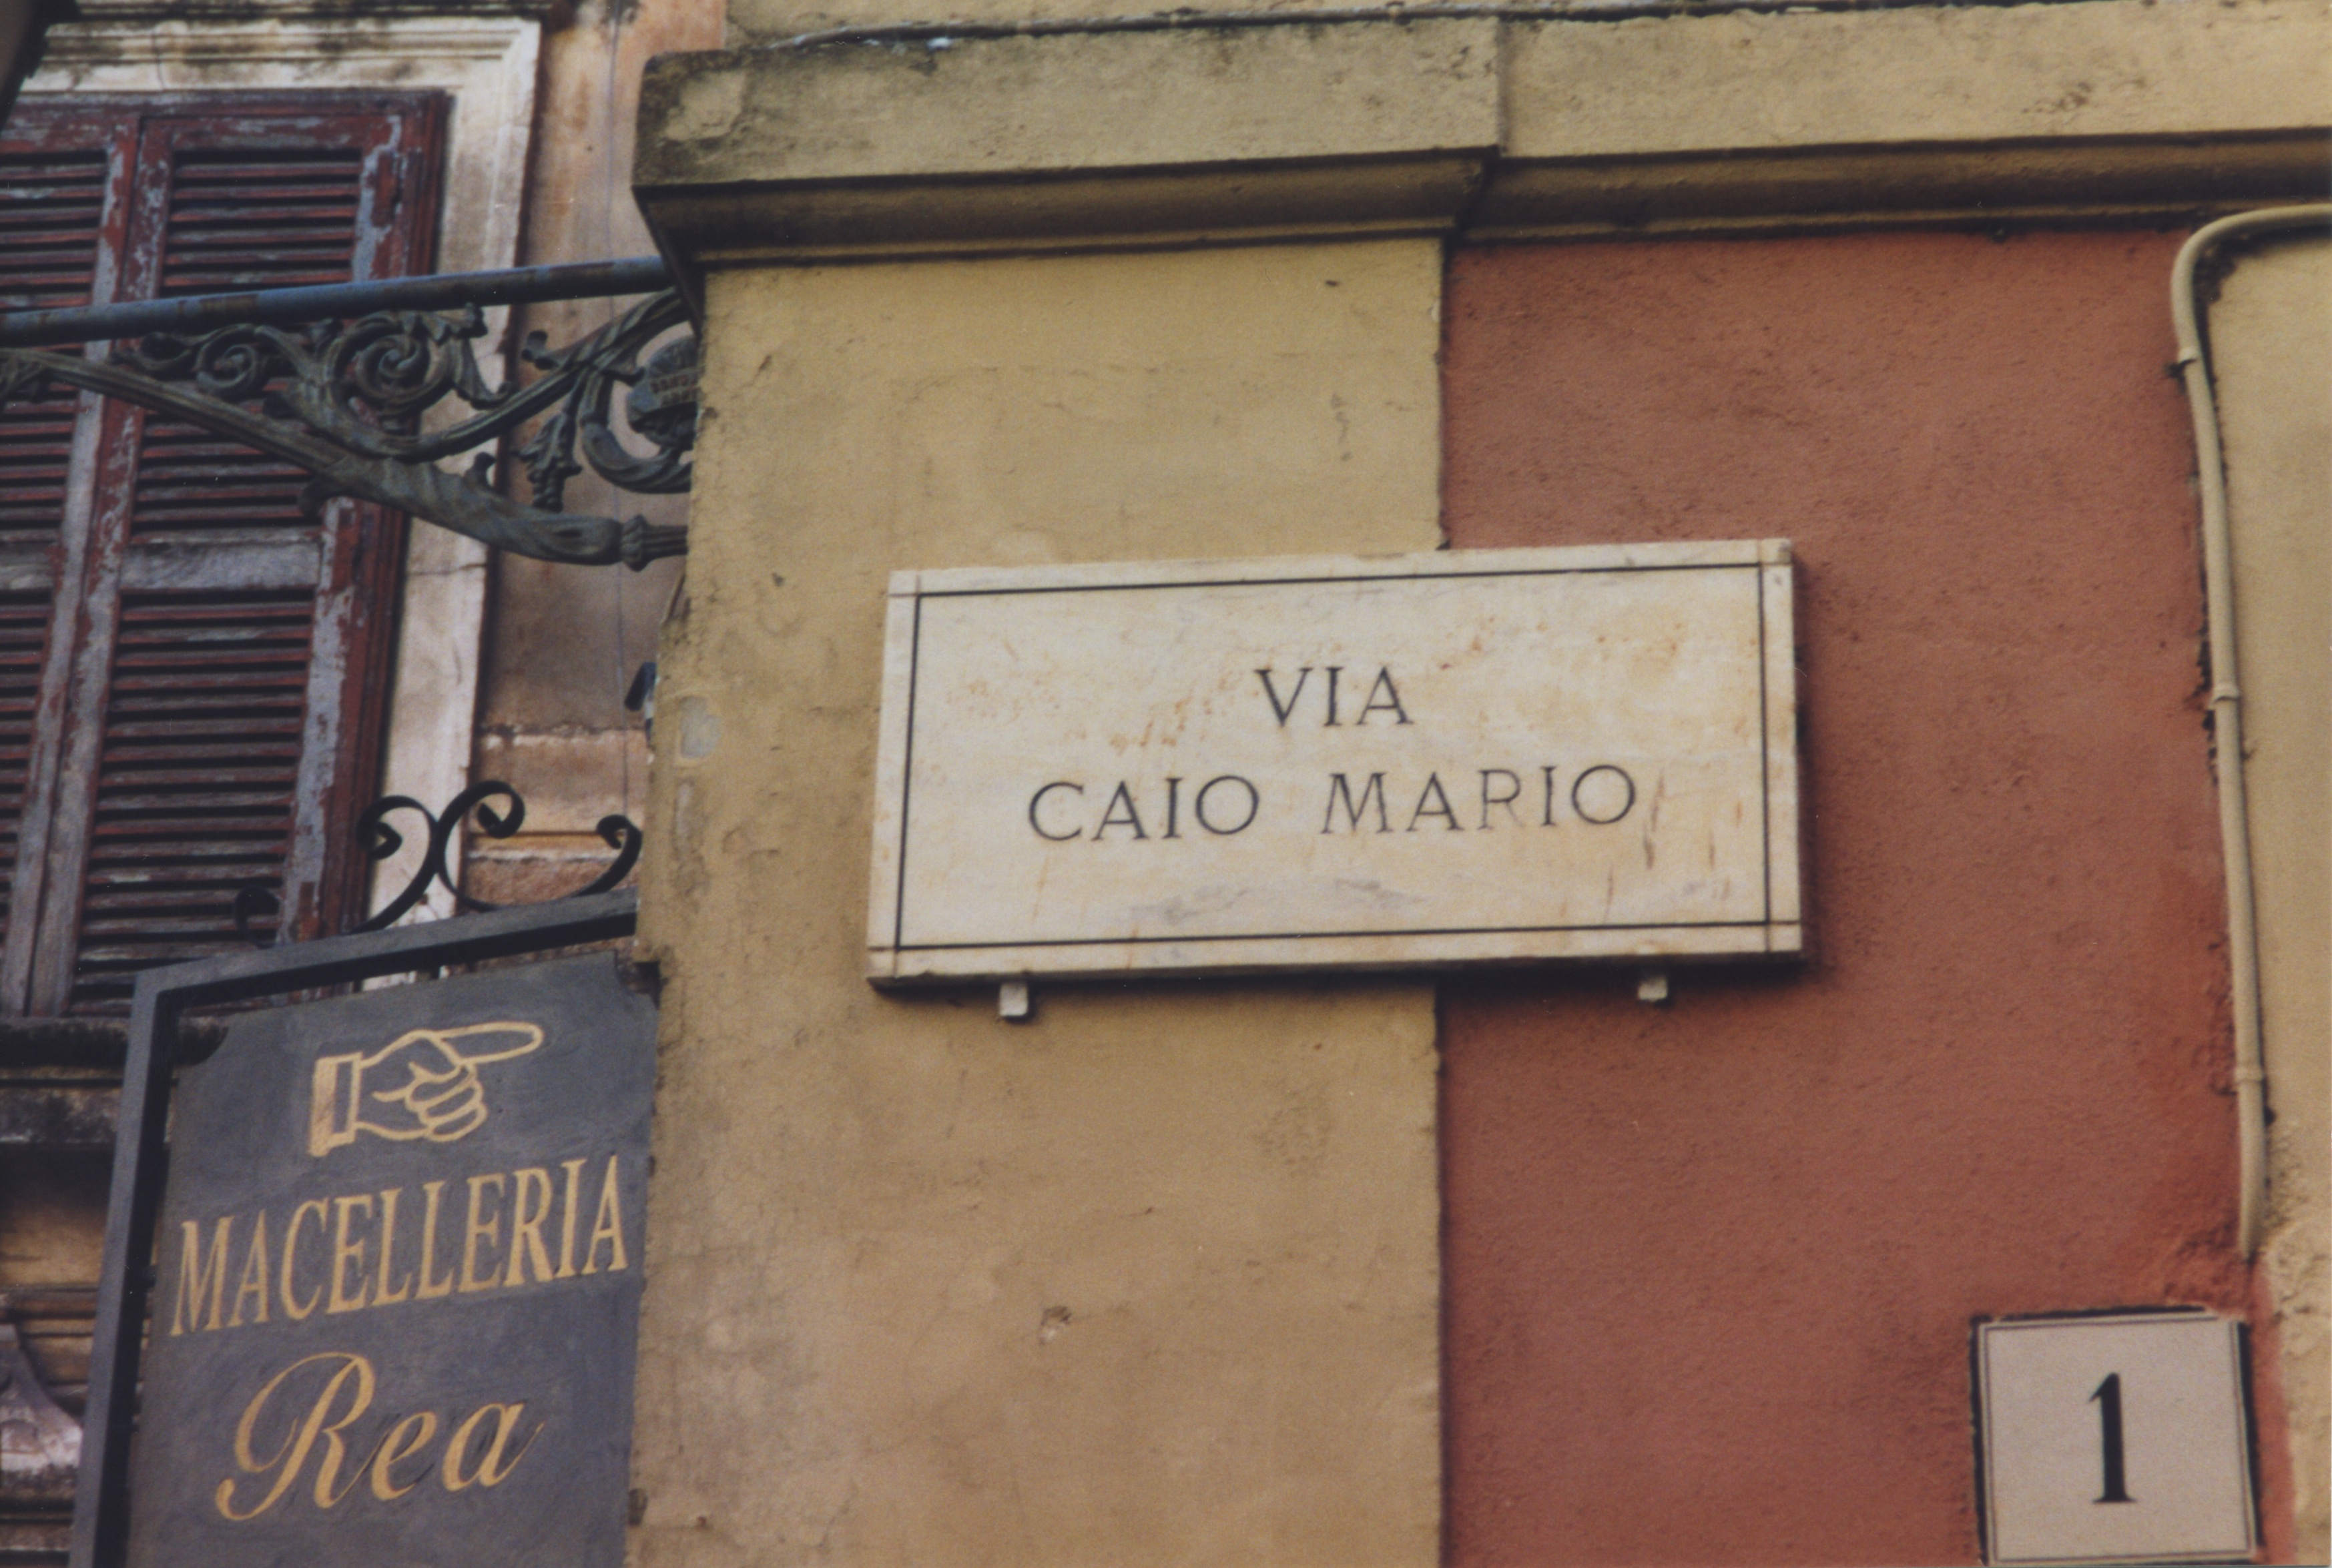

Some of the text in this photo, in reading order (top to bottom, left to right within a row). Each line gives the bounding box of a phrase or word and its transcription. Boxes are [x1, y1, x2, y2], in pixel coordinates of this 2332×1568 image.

[1254, 665, 1415, 727] VIA
[1028, 763, 1637, 841] CAIO MARIO
[169, 1154, 629, 1336] MACELLERIA
[215, 1352, 545, 1521] Rea
[2088, 1372, 2138, 1504] 1
